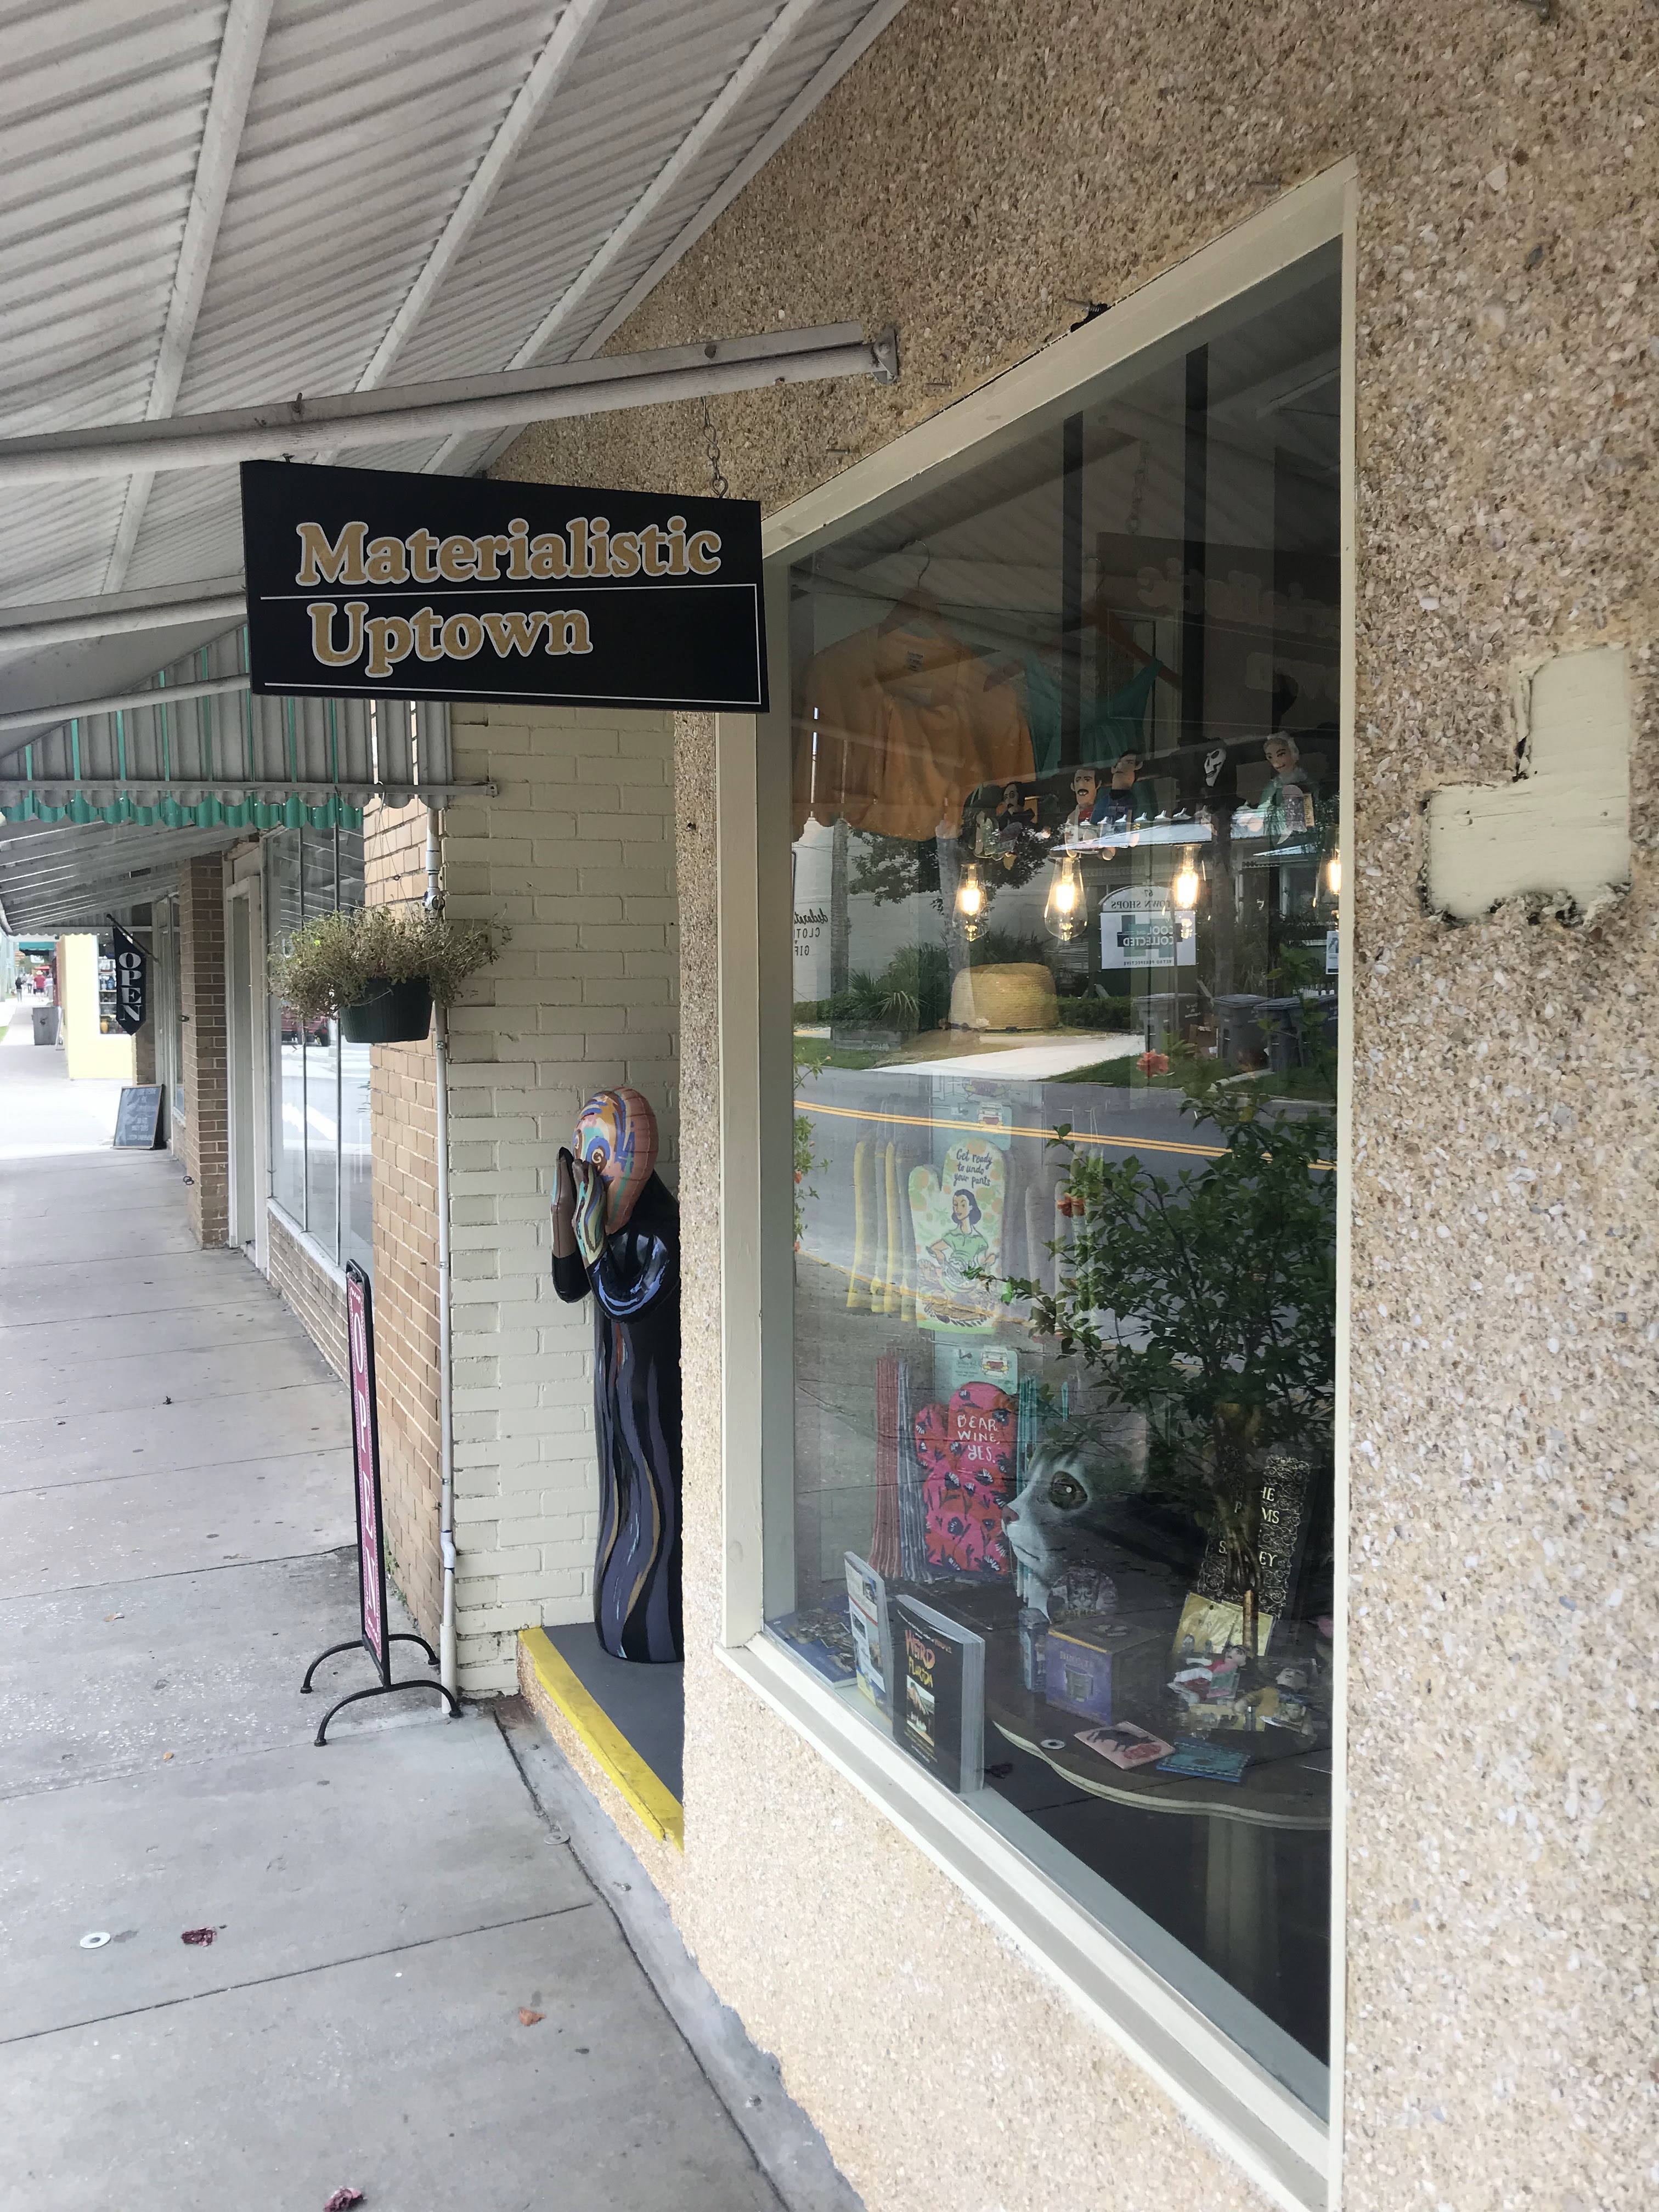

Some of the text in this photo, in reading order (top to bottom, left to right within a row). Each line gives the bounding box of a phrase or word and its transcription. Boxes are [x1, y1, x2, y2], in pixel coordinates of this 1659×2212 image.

[296, 516, 721, 586] Materialistic
[307, 601, 594, 678] Uptown
[117, 952, 143, 1022] OPEN
[953, 1173, 991, 1189] your pants
[956, 1148, 992, 1170] Get ready
[957, 1161, 984, 1175] to undo
[957, 1430, 1000, 1445] WINE,
[354, 1311, 379, 1611] OPEN
